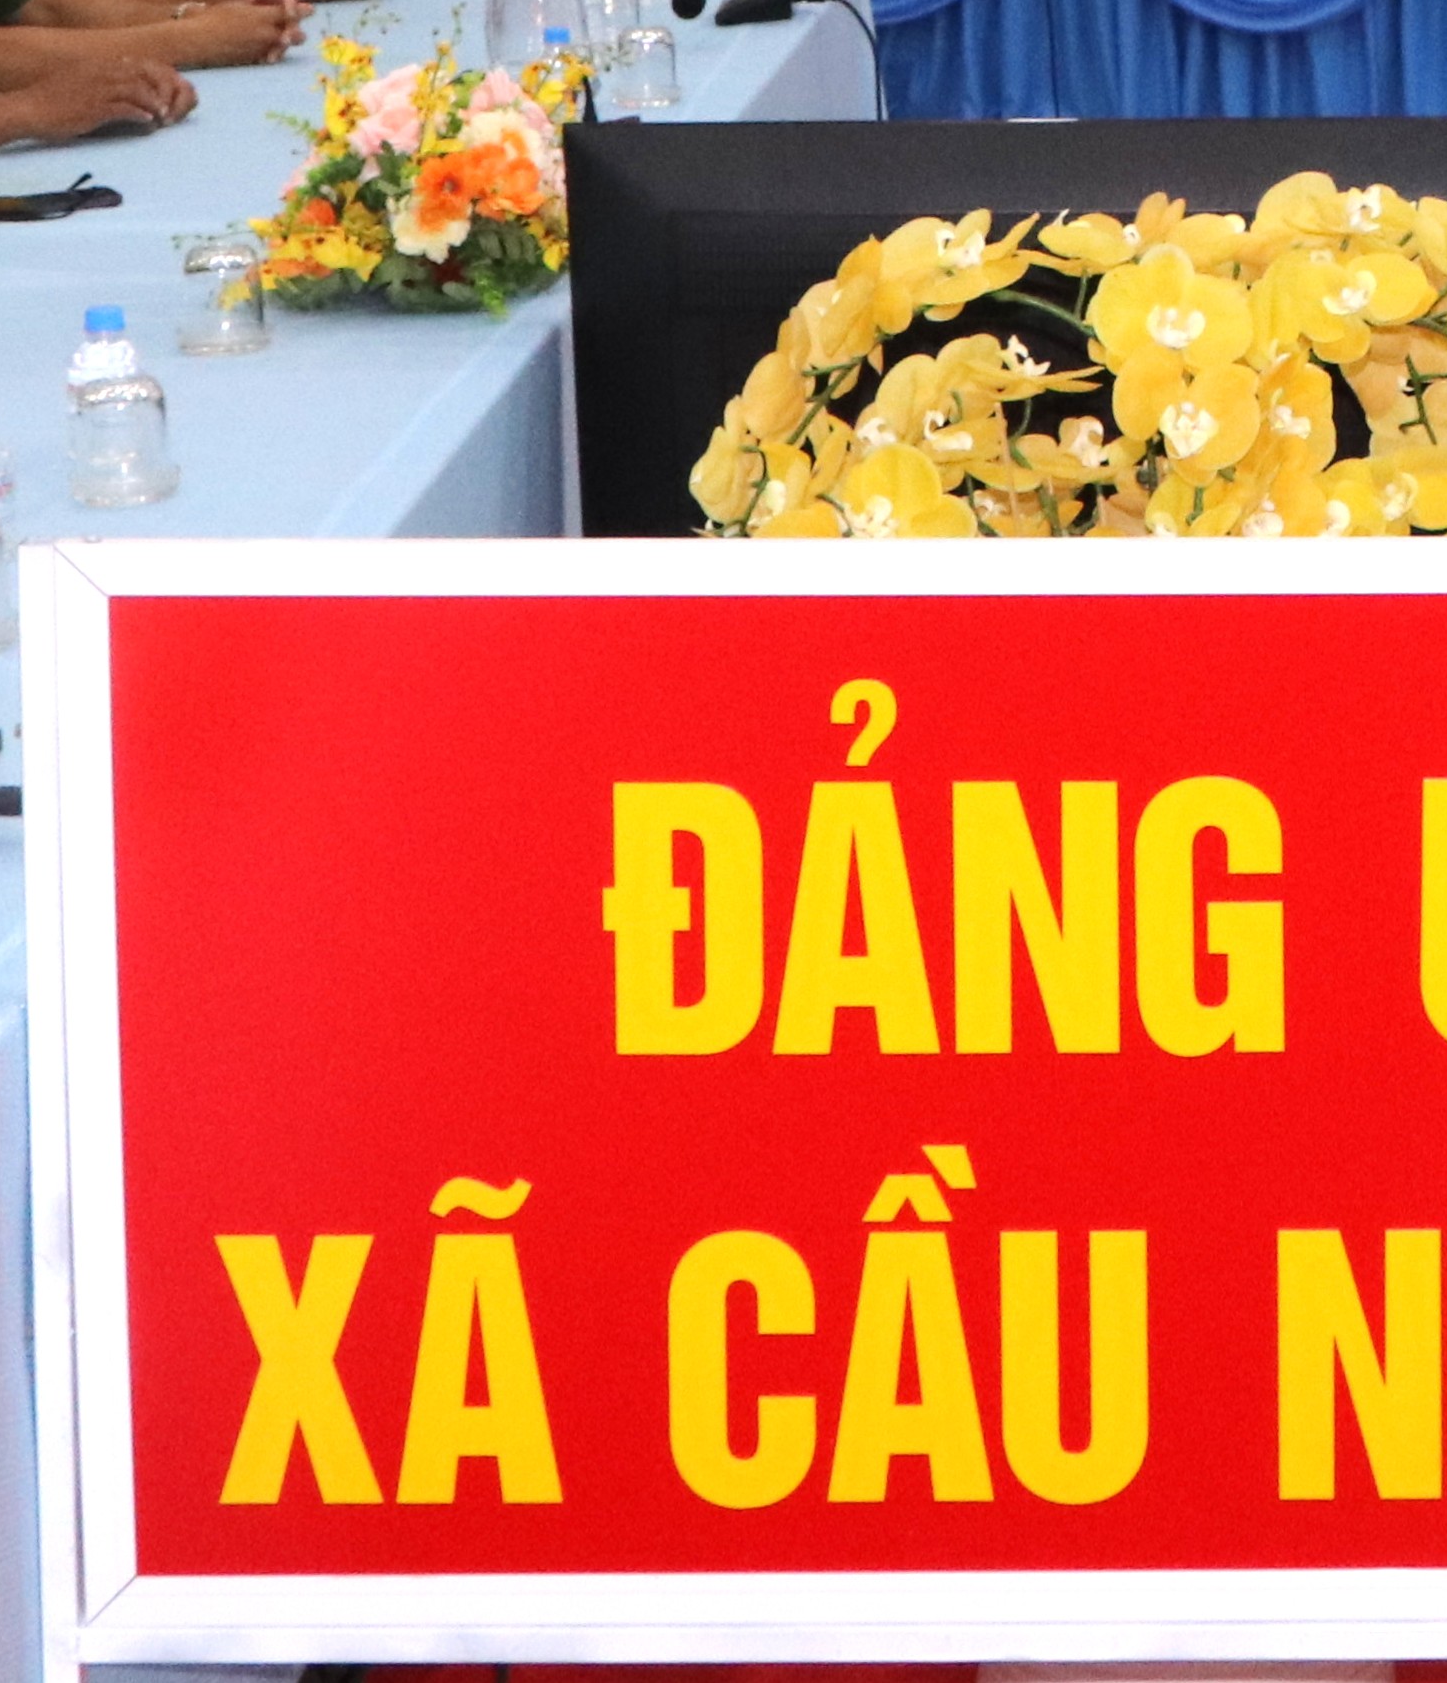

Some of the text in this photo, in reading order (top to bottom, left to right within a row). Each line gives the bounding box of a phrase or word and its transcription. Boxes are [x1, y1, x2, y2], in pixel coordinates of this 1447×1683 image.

[603, 679, 1285, 1057] ĐẢNG
[215, 1177, 563, 1504] XÃ
[668, 1145, 1148, 1509] CẦU
